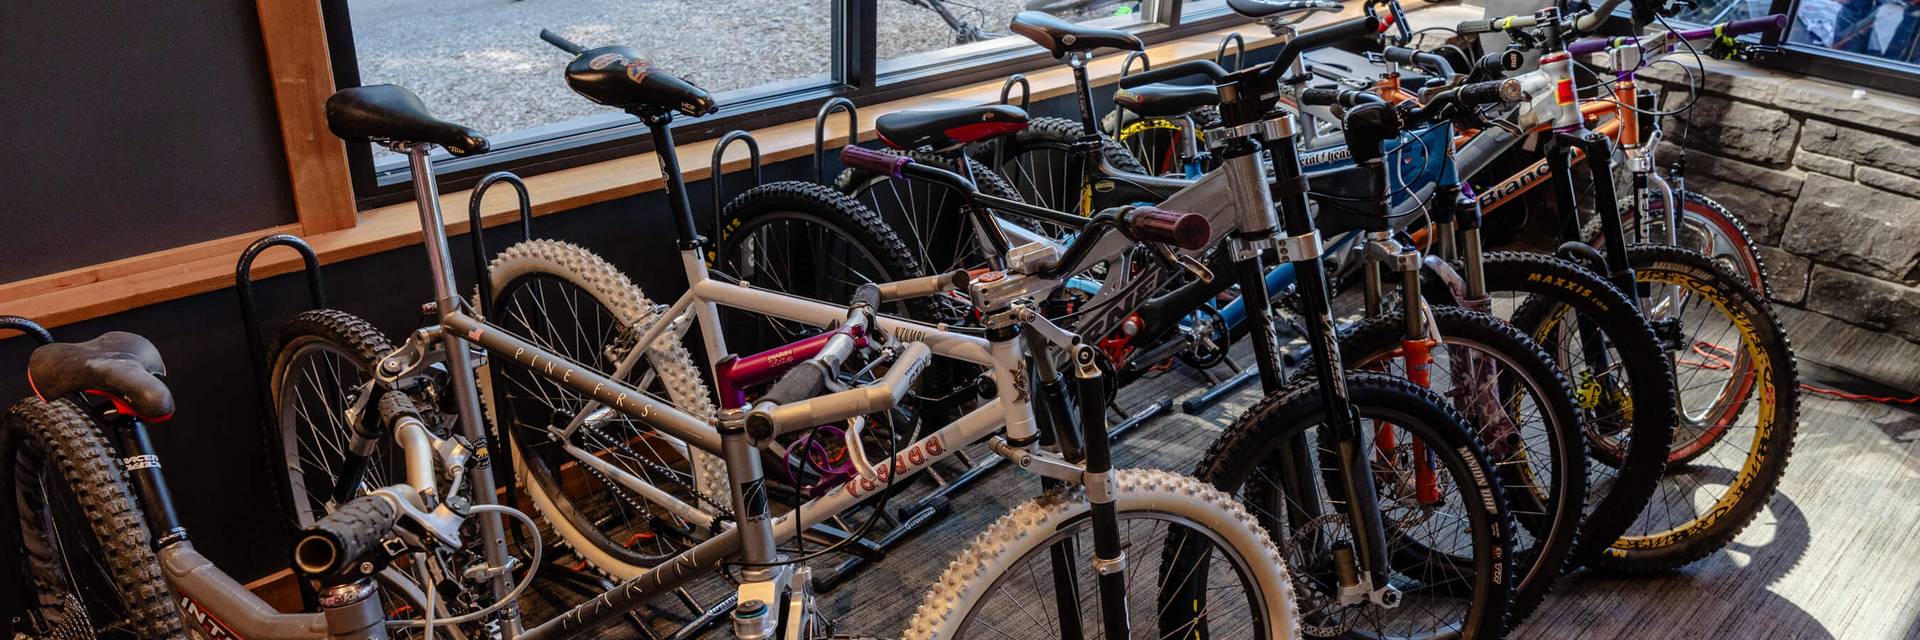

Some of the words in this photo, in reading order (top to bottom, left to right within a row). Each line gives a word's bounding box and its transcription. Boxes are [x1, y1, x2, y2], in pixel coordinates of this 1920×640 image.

[515, 347, 574, 383] PINE
[563, 549, 697, 630] MARIN
[179, 596, 233, 640] INT
